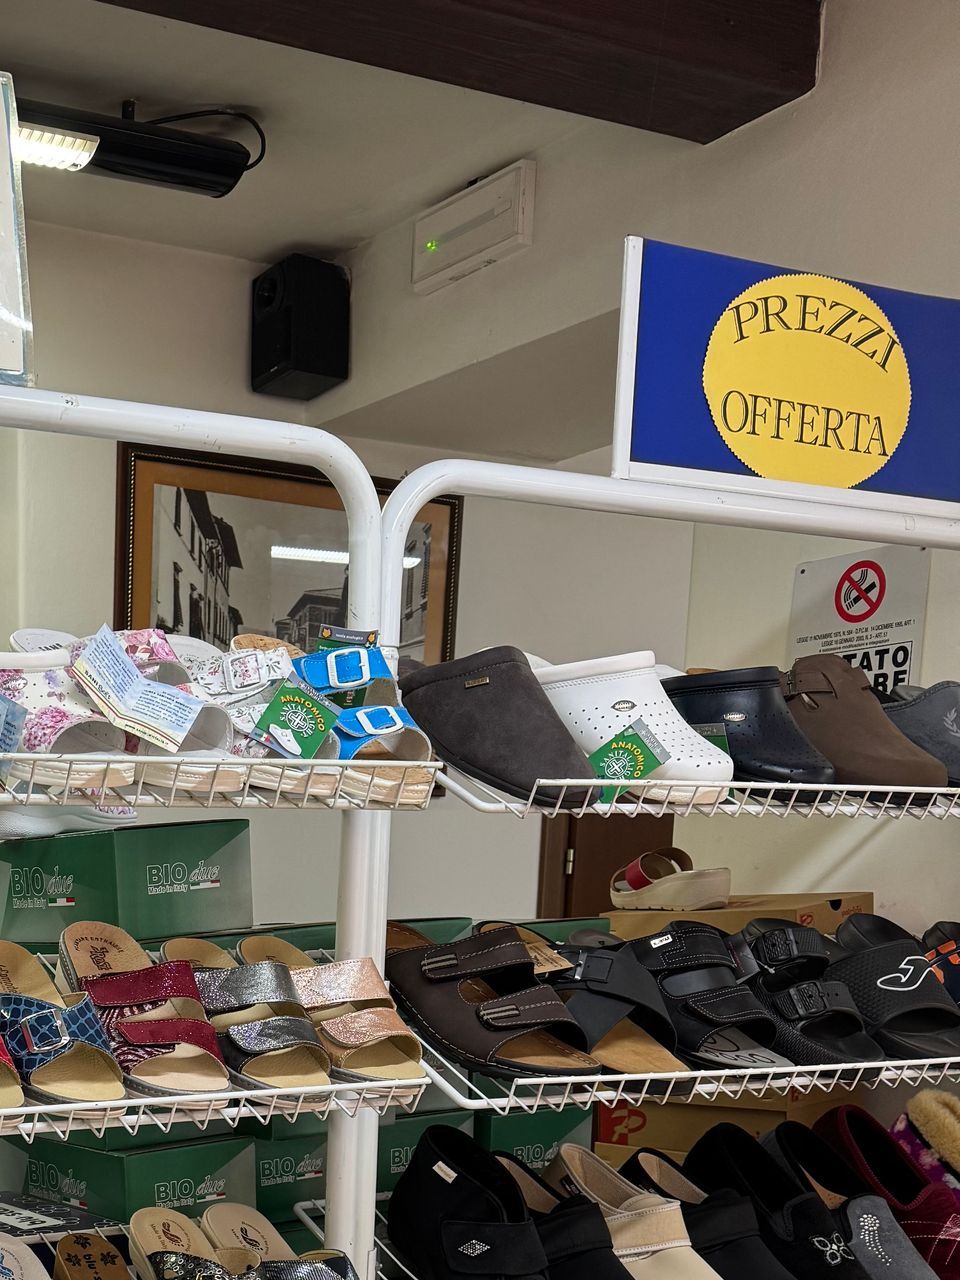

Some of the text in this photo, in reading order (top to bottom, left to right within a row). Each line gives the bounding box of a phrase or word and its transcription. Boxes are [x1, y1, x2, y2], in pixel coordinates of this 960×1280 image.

[727, 293, 902, 374] PREZZI
[720, 390, 889, 457] OFFERTA
[279, 695, 325, 731] ANATOMICO
[611, 741, 646, 778] ANATOMICO
[11, 865, 73, 896] BIO due
[147, 860, 220, 886] BIO due
[148, 886, 166, 894] Made
[173, 884, 188, 893] Italy
[260, 1153, 323, 1178] BIO due
[514, 1145, 544, 1162] BIO
[28, 1159, 60, 1190] BIO
[155, 1174, 226, 1202] BIO due
